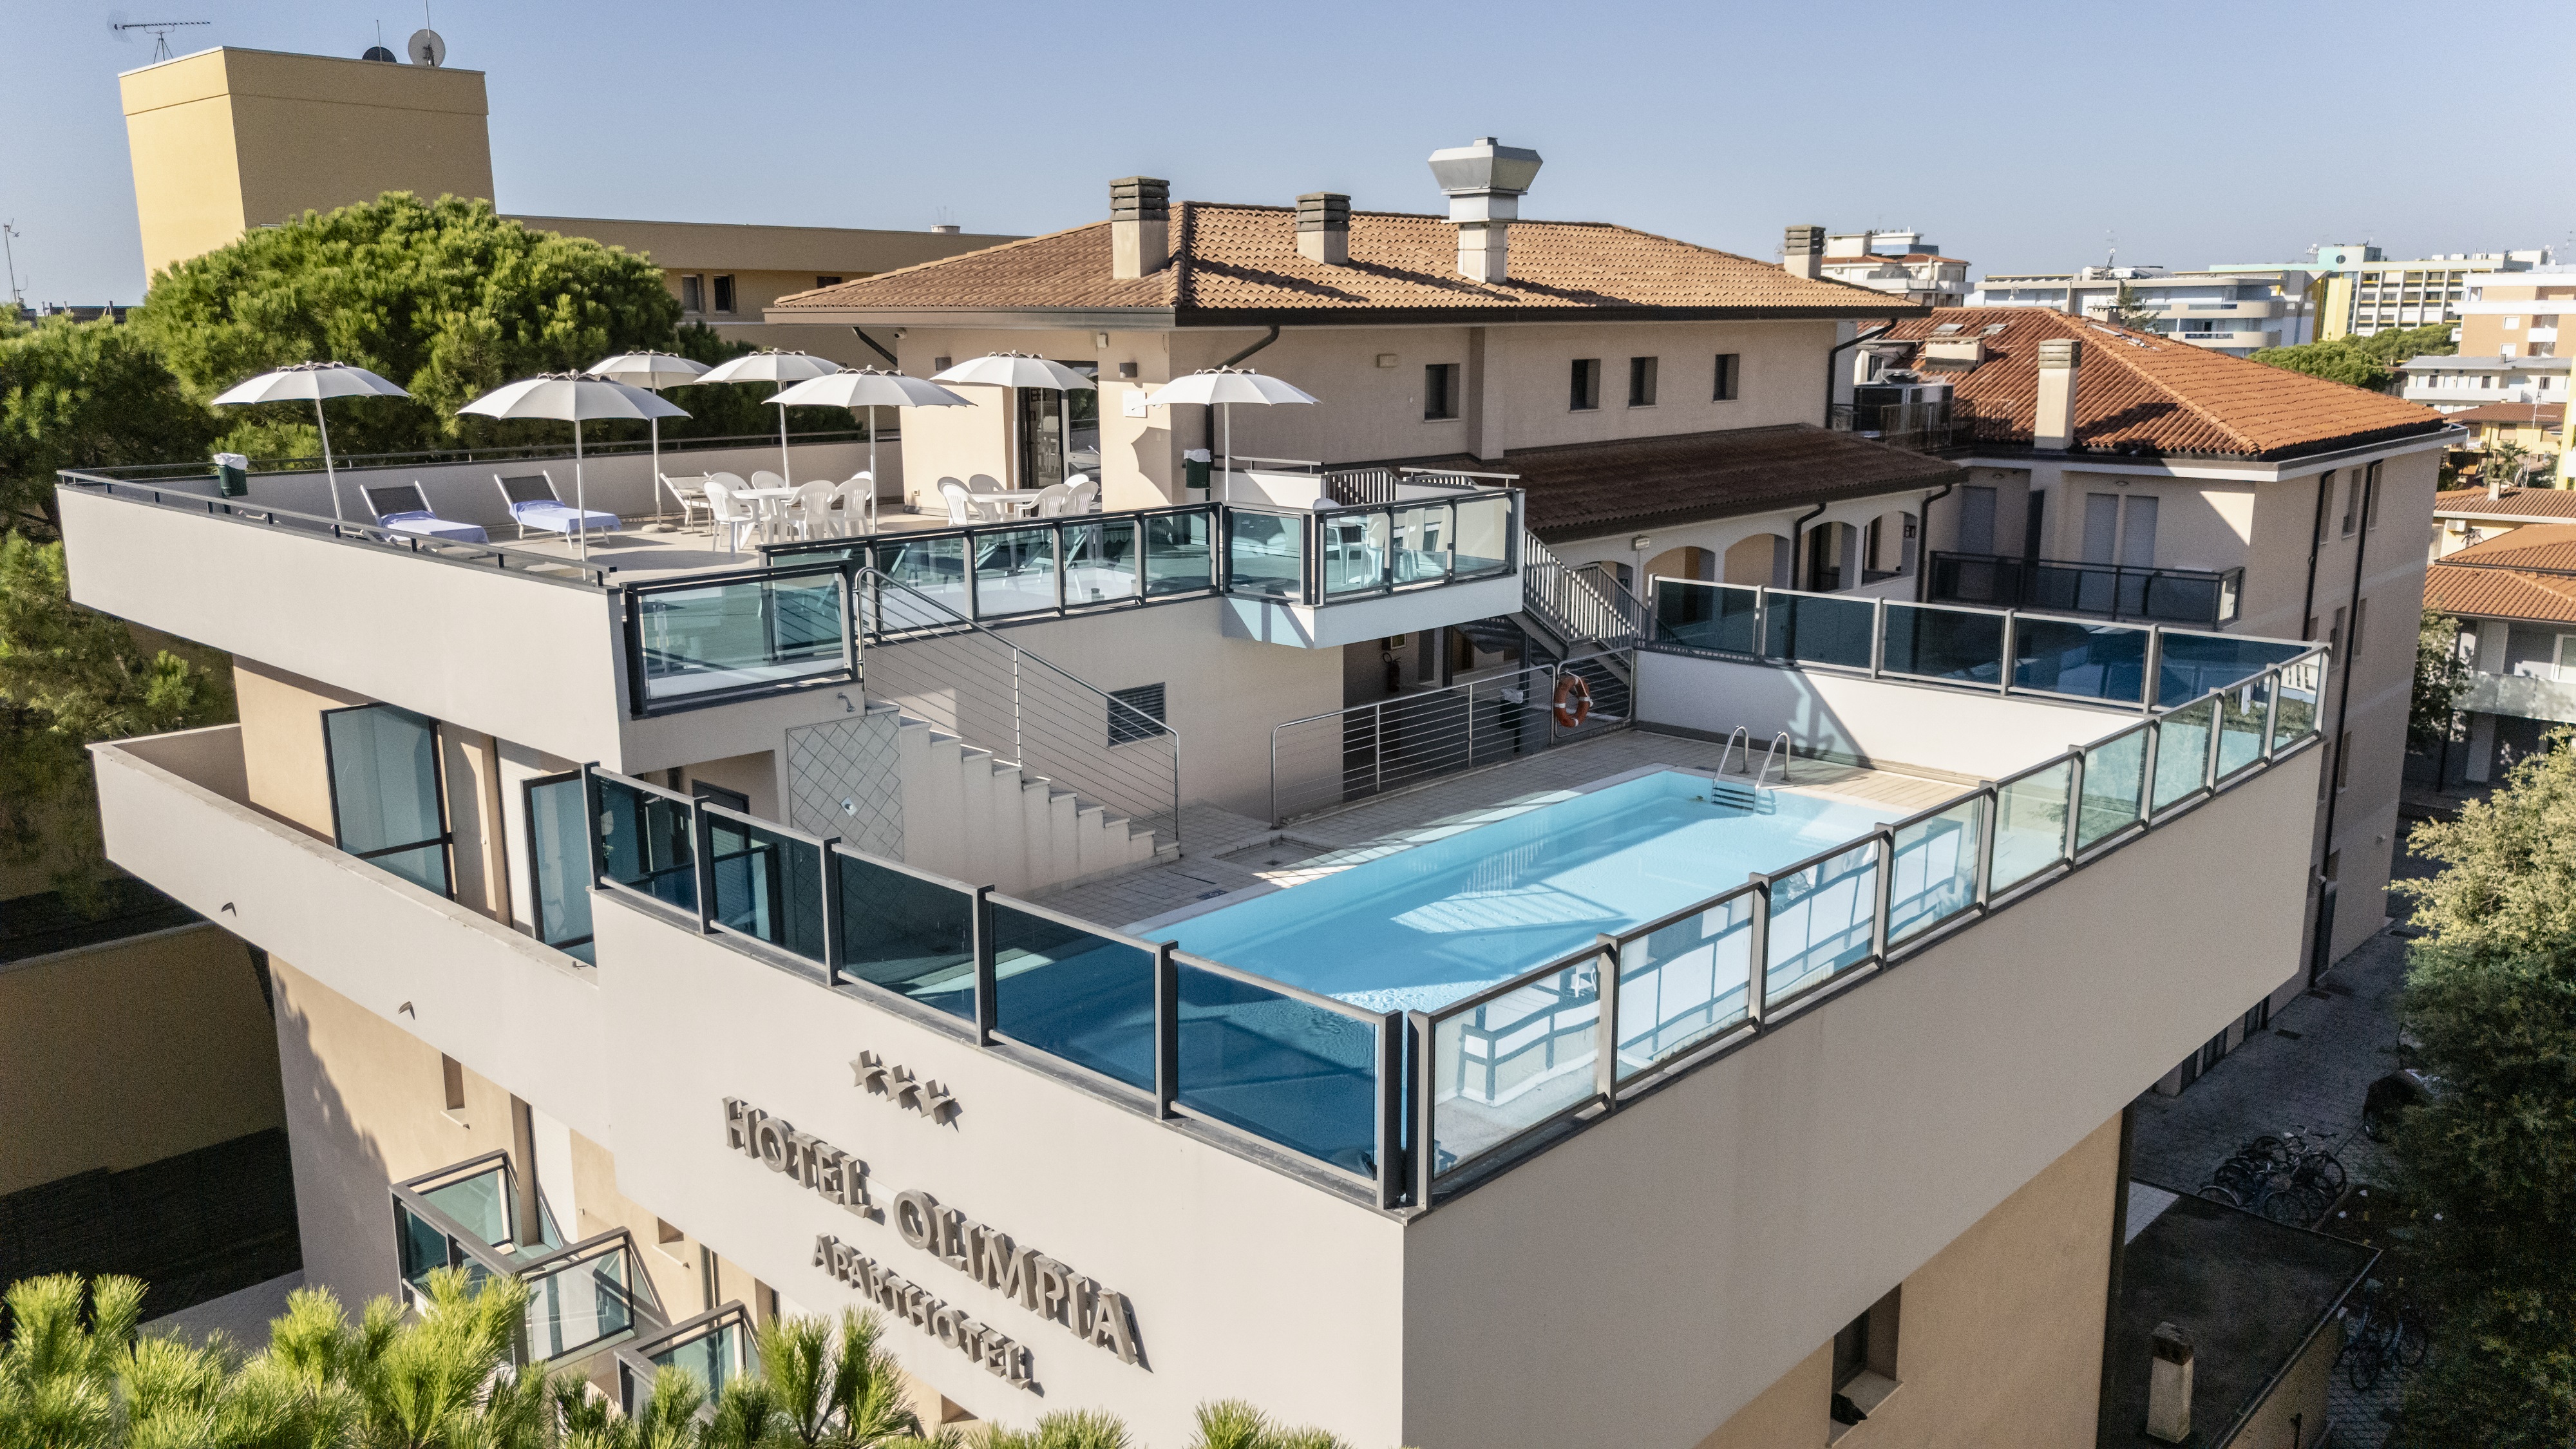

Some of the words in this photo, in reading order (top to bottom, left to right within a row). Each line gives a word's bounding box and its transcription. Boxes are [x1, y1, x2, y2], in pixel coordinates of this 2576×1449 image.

[722, 1096, 873, 1218] HOTEL
[893, 1189, 1139, 1365] OLIMPIA
[811, 1233, 1032, 1390] APARTHOTEL
